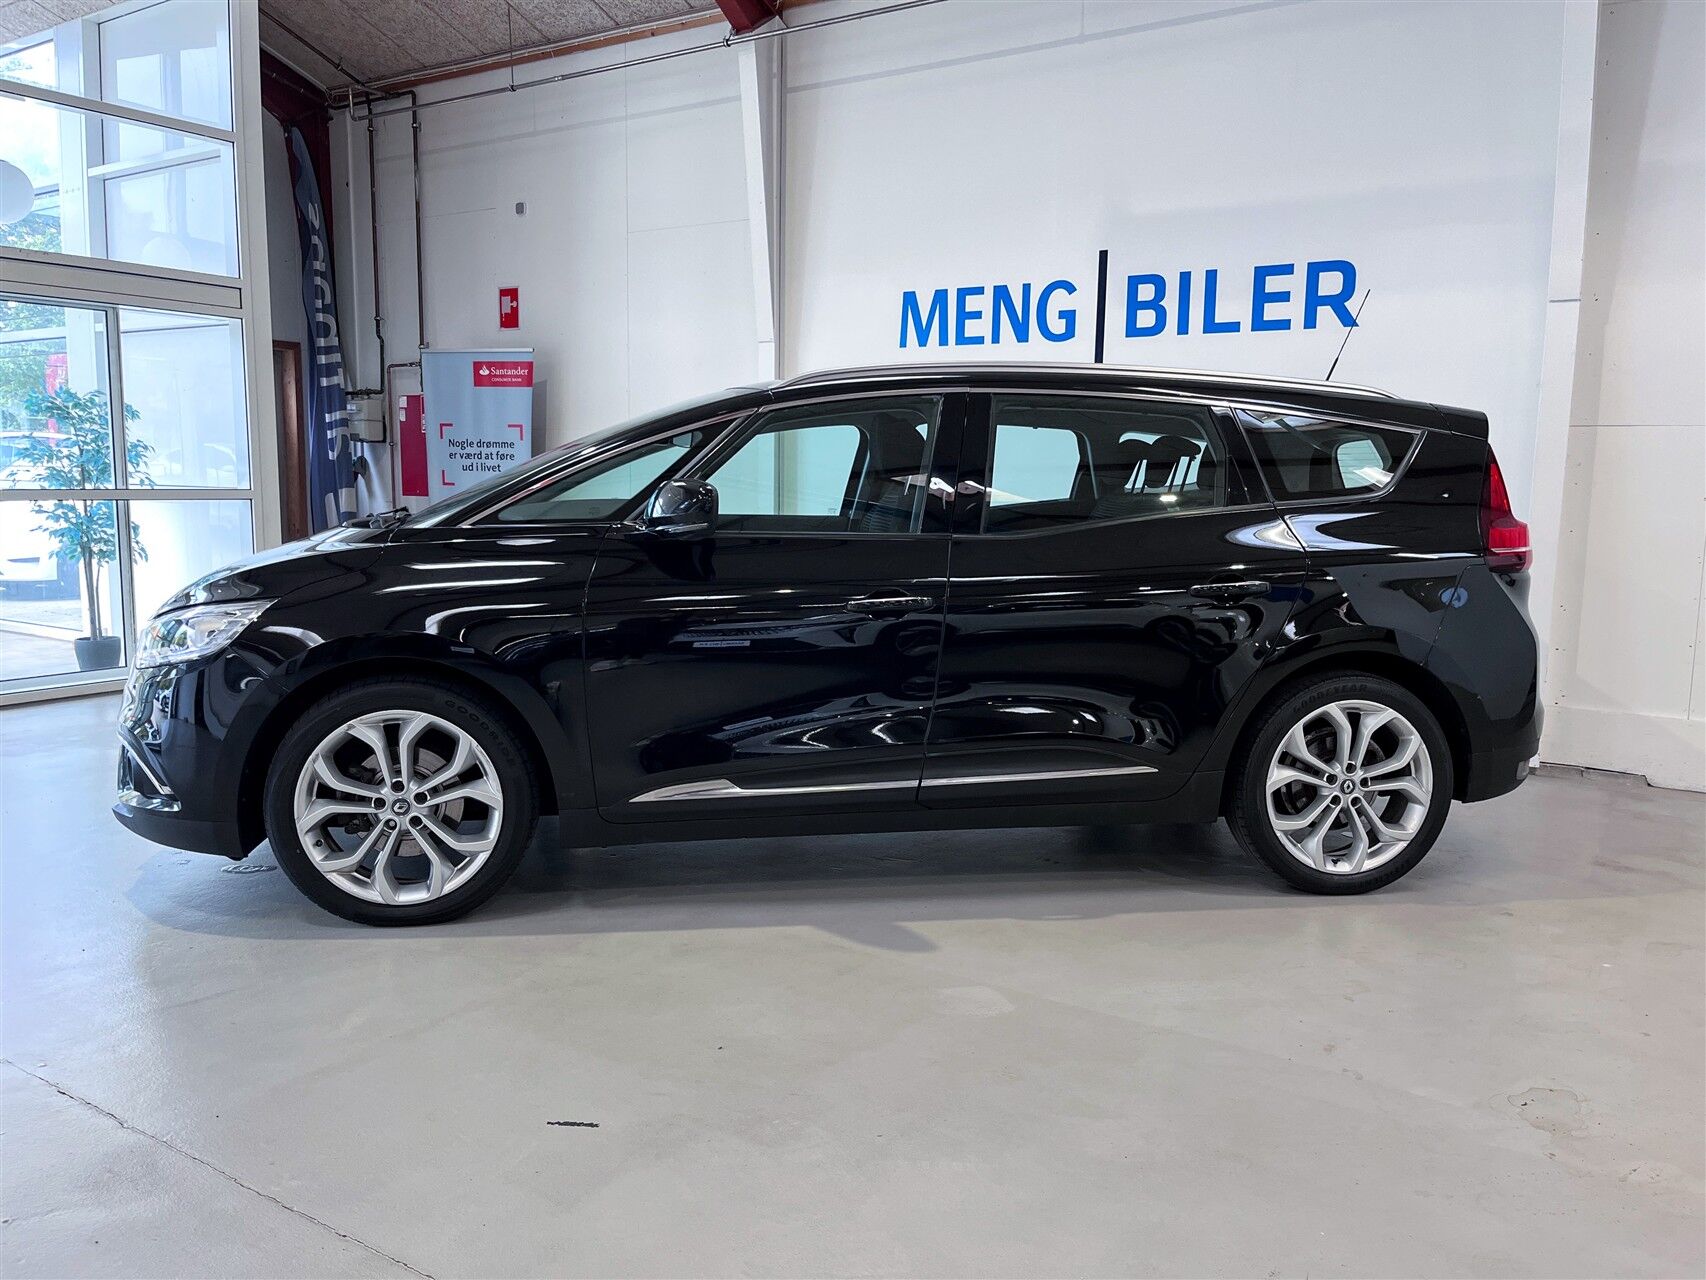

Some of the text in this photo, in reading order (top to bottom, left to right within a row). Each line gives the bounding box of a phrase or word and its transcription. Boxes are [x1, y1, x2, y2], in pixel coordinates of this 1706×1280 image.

[899, 259, 1360, 348] MENG BILER
[490, 366, 529, 376] Santander
[448, 439, 515, 450] Nogle drømme
[448, 451, 515, 461] er værd at føre
[461, 463, 502, 473] ud i livet
